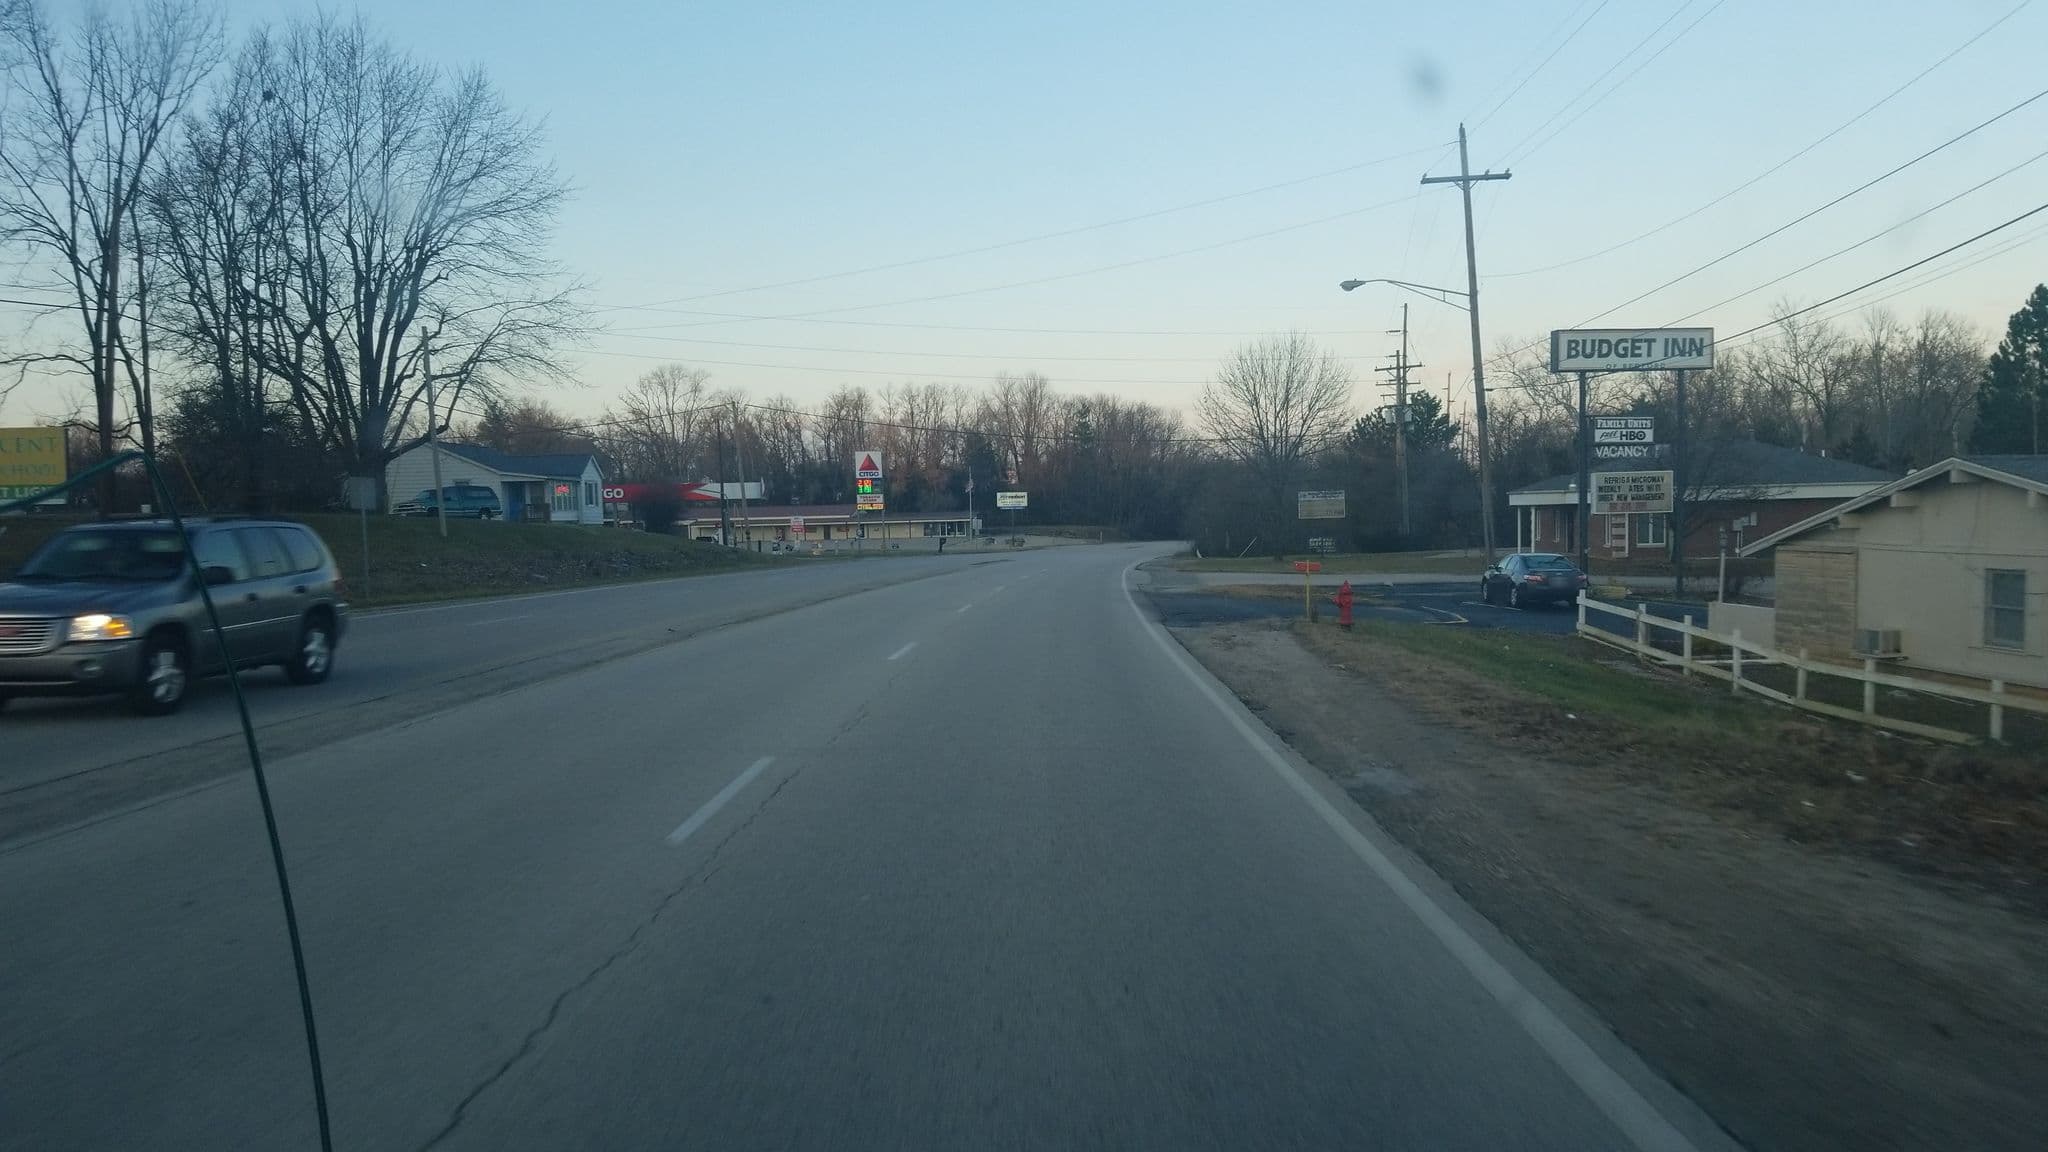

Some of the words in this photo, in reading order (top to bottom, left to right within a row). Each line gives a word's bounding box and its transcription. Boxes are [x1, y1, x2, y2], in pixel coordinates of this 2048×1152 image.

[1567, 338, 1656, 359] BUDGET
[1664, 338, 1704, 358] INN
[1597, 419, 1626, 428] FAMILY
[1627, 419, 1652, 428] UNITS
[1619, 430, 1646, 441] HBO
[1595, 445, 1649, 458] VACANCY
[601, 488, 624, 499] GO
